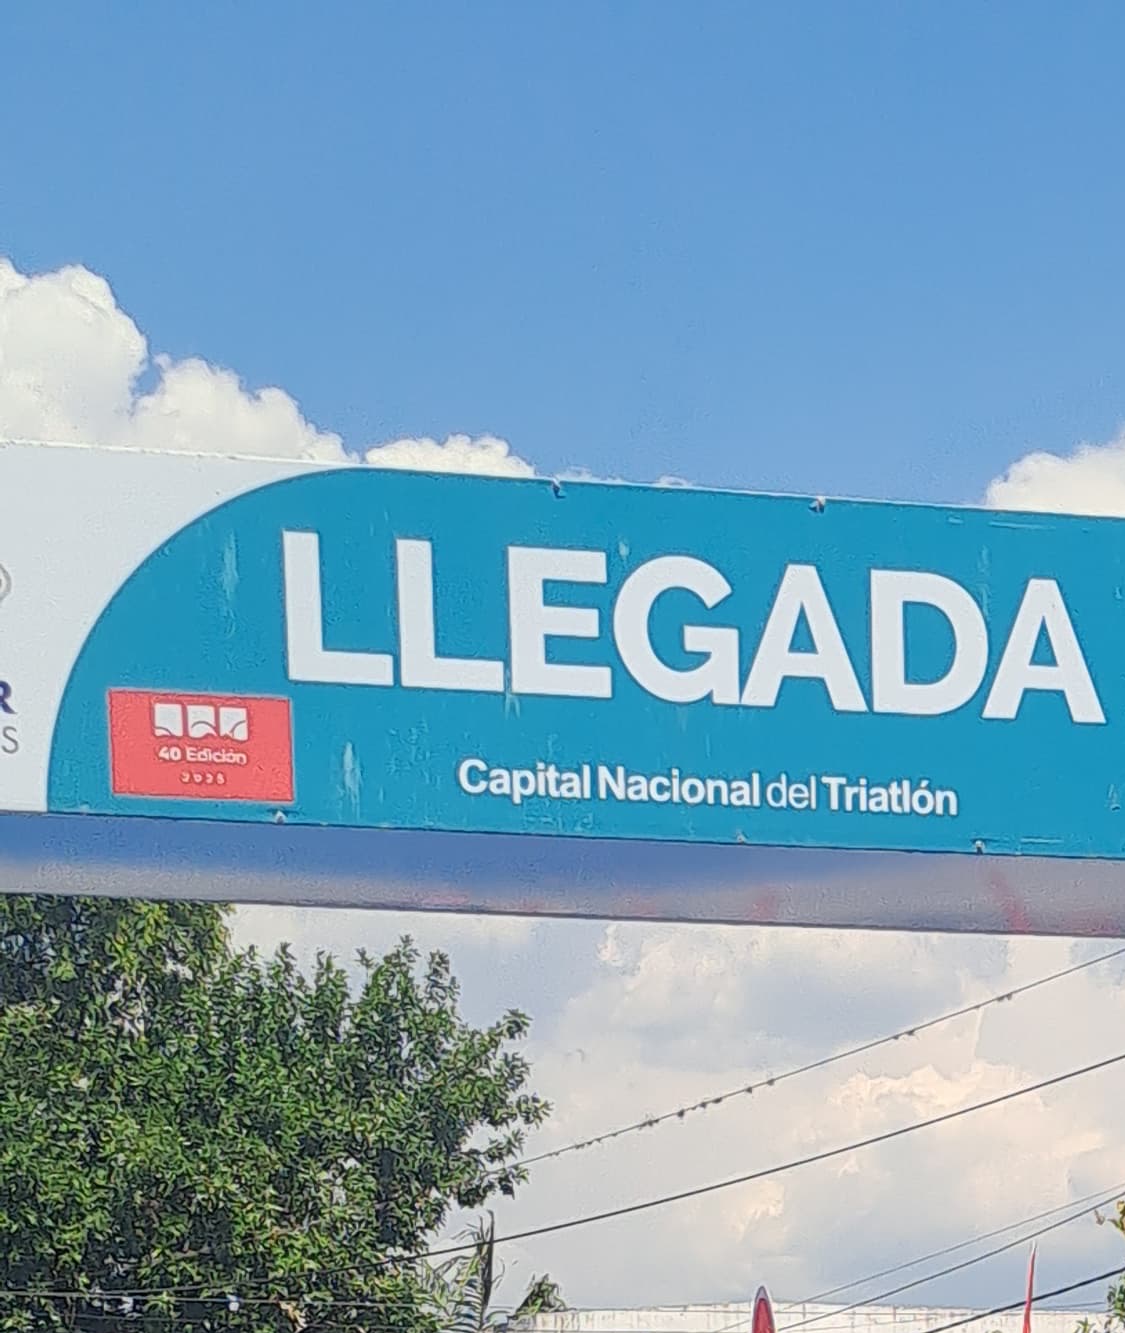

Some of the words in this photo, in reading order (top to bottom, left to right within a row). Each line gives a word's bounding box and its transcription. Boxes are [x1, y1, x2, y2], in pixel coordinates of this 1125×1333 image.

[282, 530, 1107, 724] LLEGADA
[158, 746, 182, 762] 40
[459, 757, 591, 803] Capital
[598, 765, 760, 807] Nacional
[767, 774, 817, 810] del
[822, 776, 958, 817] Triatlón
